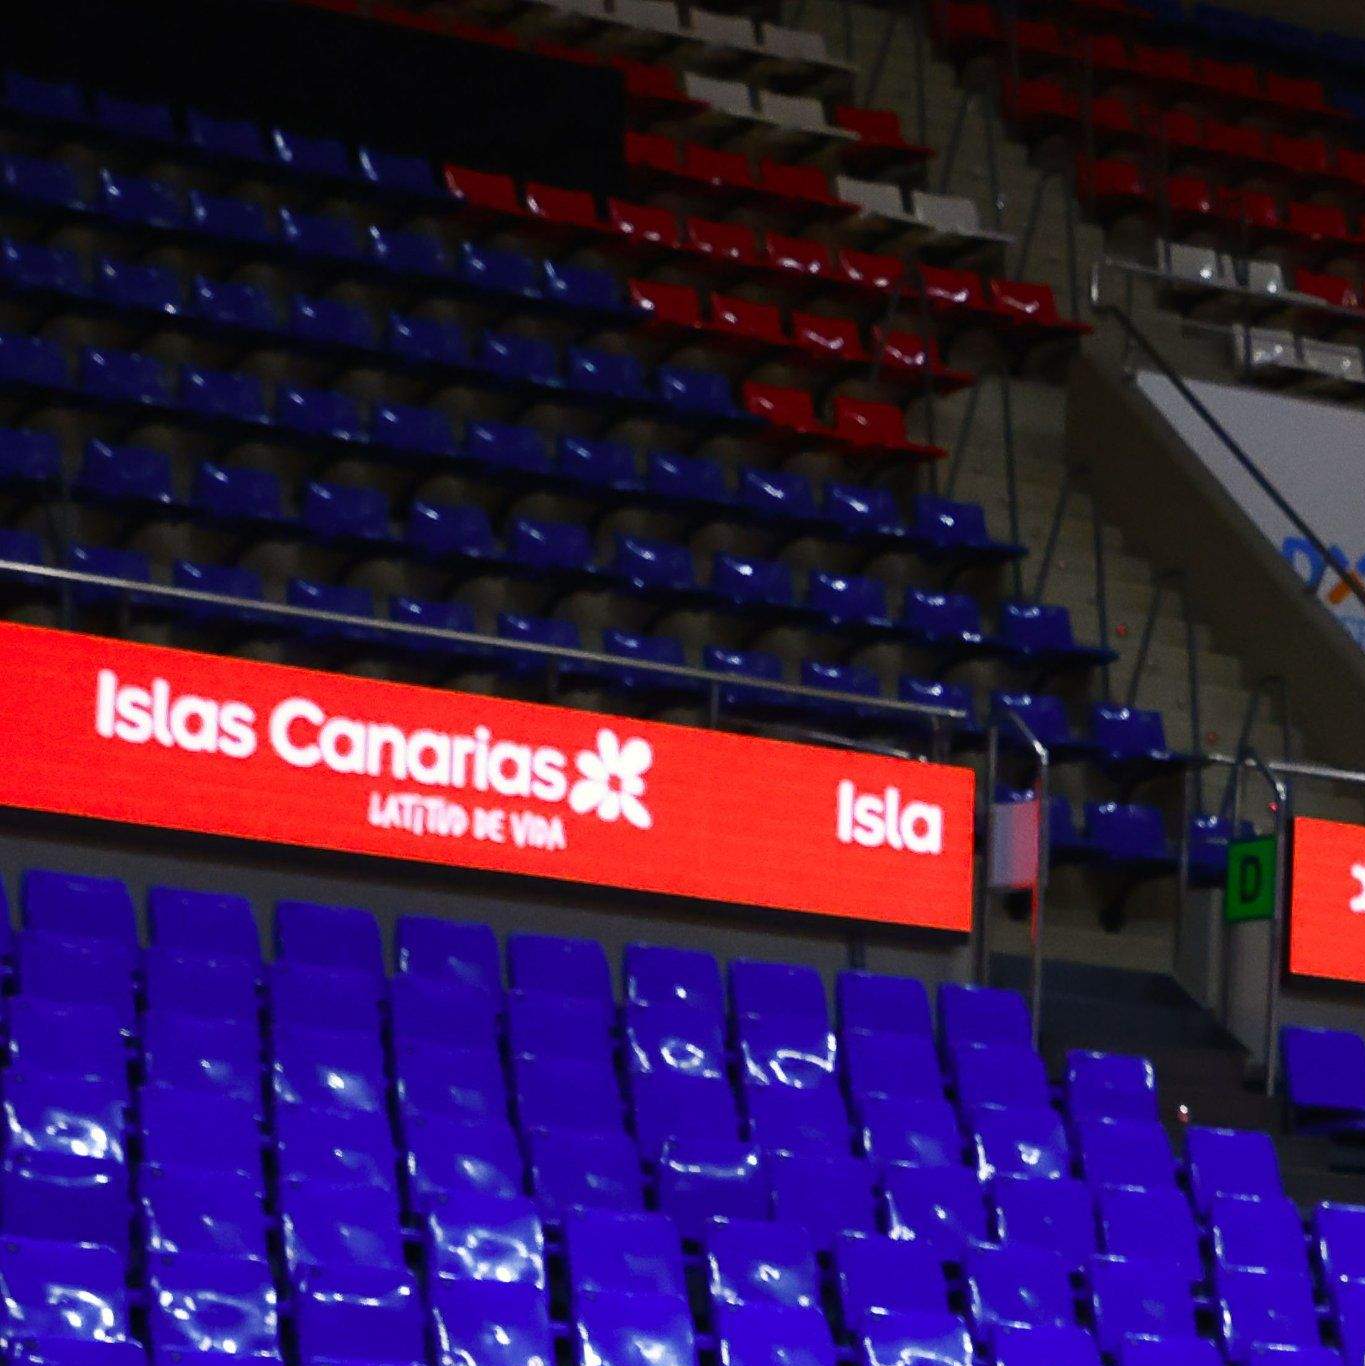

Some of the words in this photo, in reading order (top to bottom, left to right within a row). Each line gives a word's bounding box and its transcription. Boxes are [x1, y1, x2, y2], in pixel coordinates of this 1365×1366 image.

[95, 668, 257, 758] Islas
[268, 697, 567, 801] Canarias
[472, 806, 506, 844] DE
[836, 779, 943, 854] Isla
